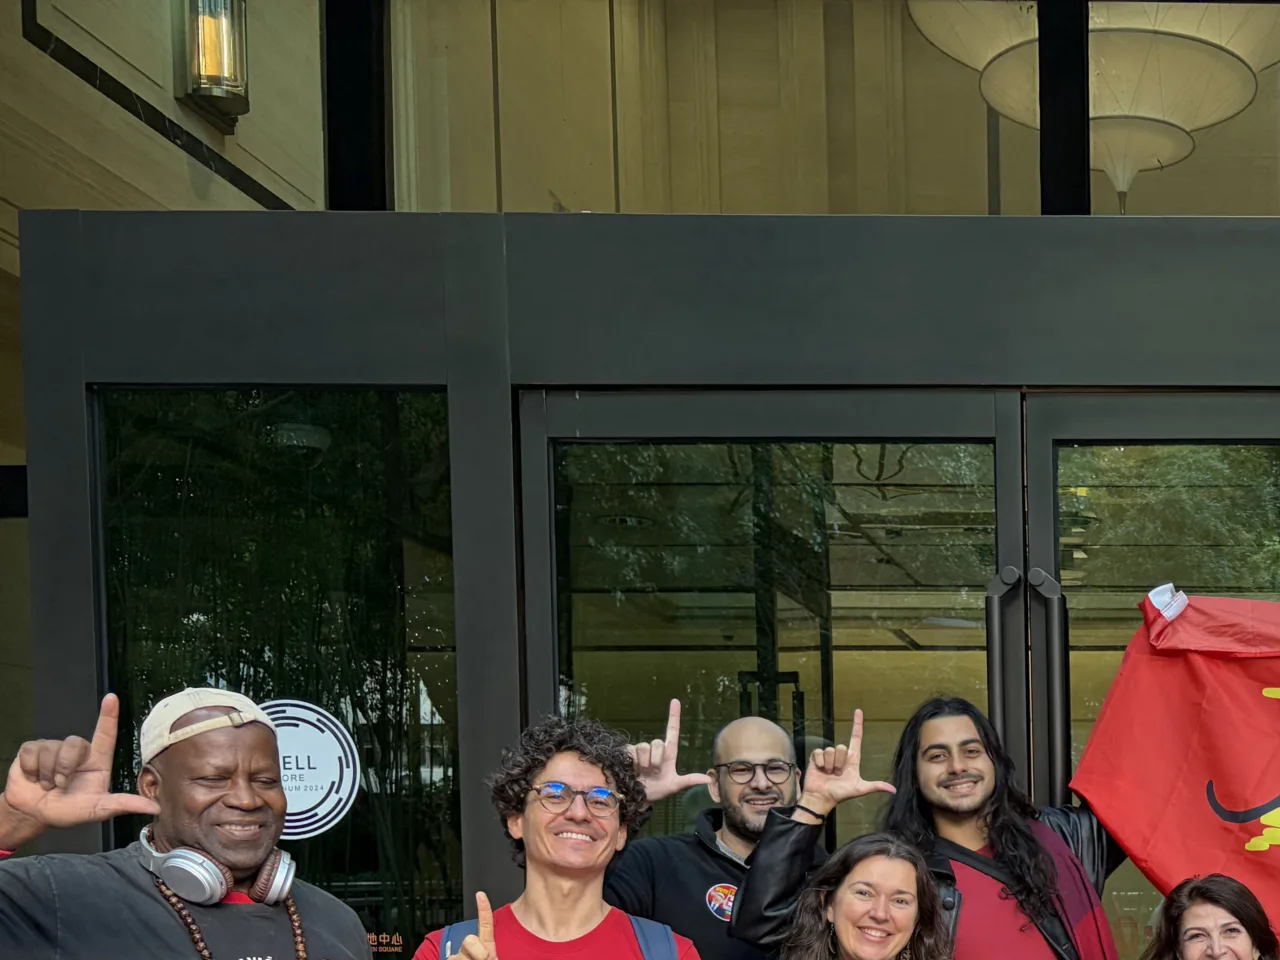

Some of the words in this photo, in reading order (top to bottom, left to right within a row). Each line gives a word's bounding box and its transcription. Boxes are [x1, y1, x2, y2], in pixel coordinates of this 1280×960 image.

[282, 755, 317, 770] ELL
[282, 773, 305, 782] ORE
[303, 784, 325, 792] 2024
